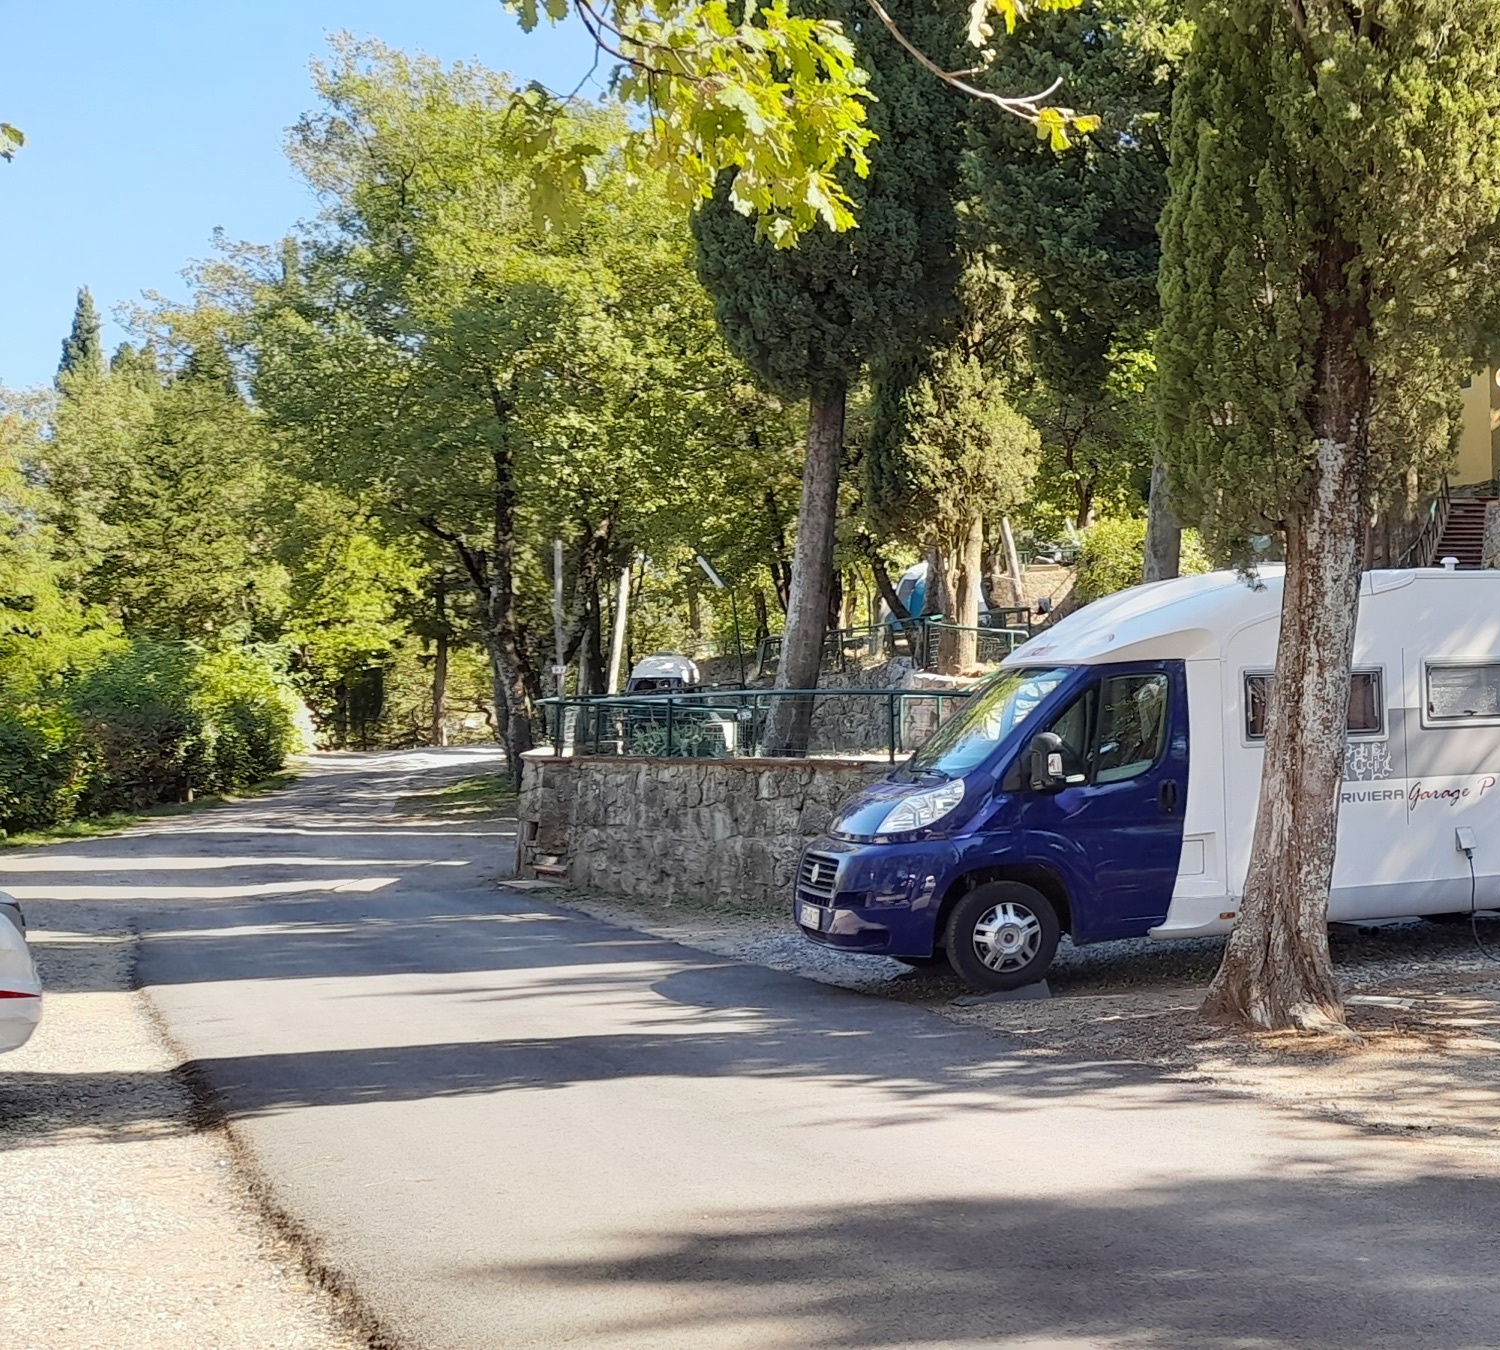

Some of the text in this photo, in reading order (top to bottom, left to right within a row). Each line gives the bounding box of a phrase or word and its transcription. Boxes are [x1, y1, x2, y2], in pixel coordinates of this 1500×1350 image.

[1341, 775, 1496, 811] RIVIERA Garage P
